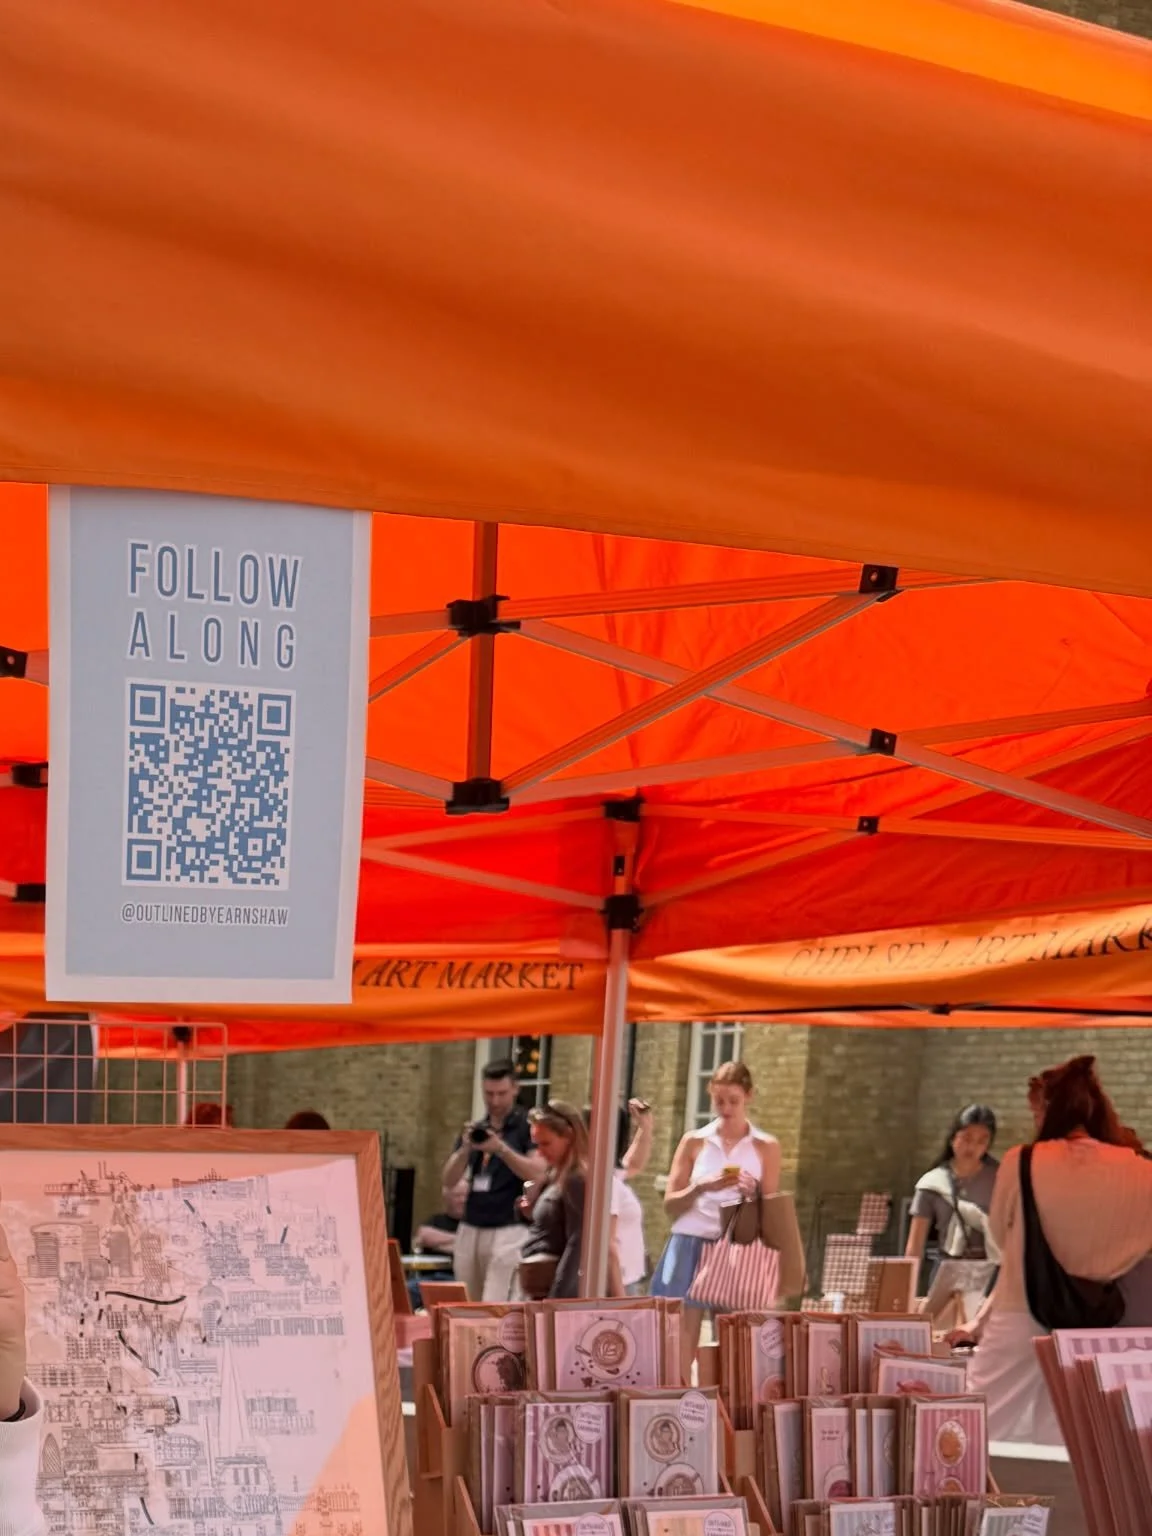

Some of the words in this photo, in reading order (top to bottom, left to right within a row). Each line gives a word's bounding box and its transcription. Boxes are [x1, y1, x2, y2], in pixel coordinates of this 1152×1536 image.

[130, 542, 300, 609] FOLLOW
[129, 610, 295, 669] ALONG
[122, 903, 289, 925] @OUTLINEDBYEARNSHAW
[359, 959, 438, 989] ART
[436, 960, 585, 991] MARKET
